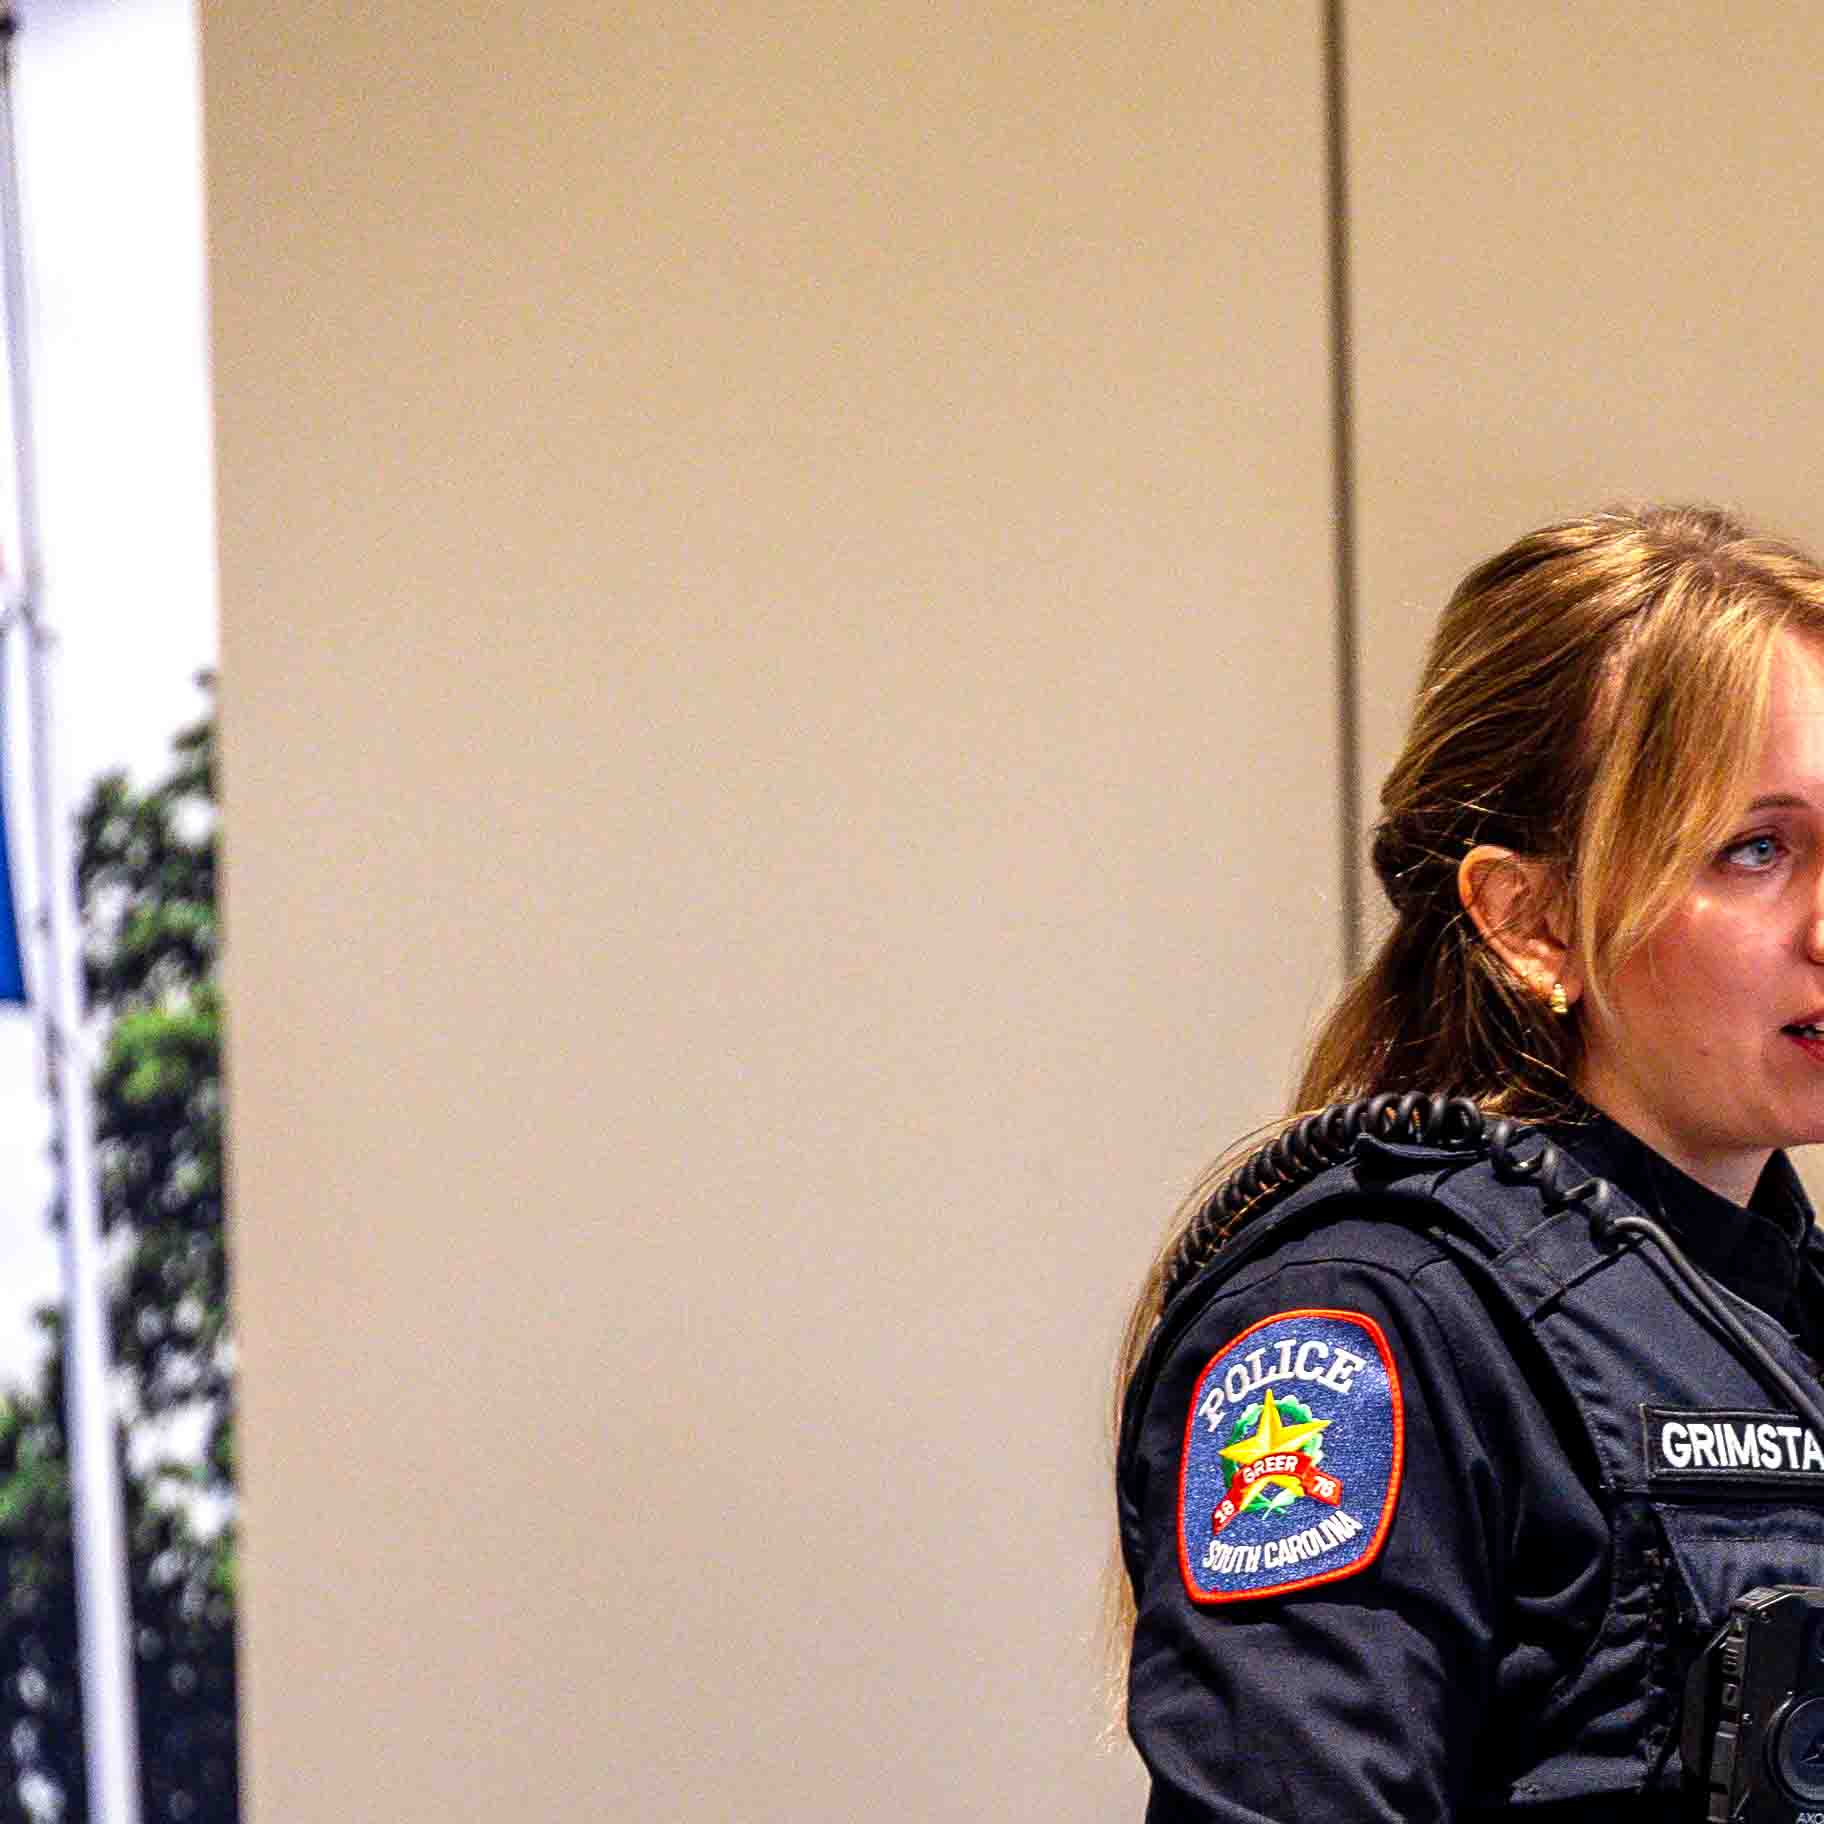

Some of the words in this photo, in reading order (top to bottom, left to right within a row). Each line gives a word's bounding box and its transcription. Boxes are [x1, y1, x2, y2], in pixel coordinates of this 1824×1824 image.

[1199, 1338, 1367, 1432] POLICE
[1243, 1455, 1298, 1484] GREER
[1313, 1475, 1336, 1498] 76
[1203, 1540, 1262, 1574] SOUTH
[1264, 1511, 1363, 1569] CAROLINA
